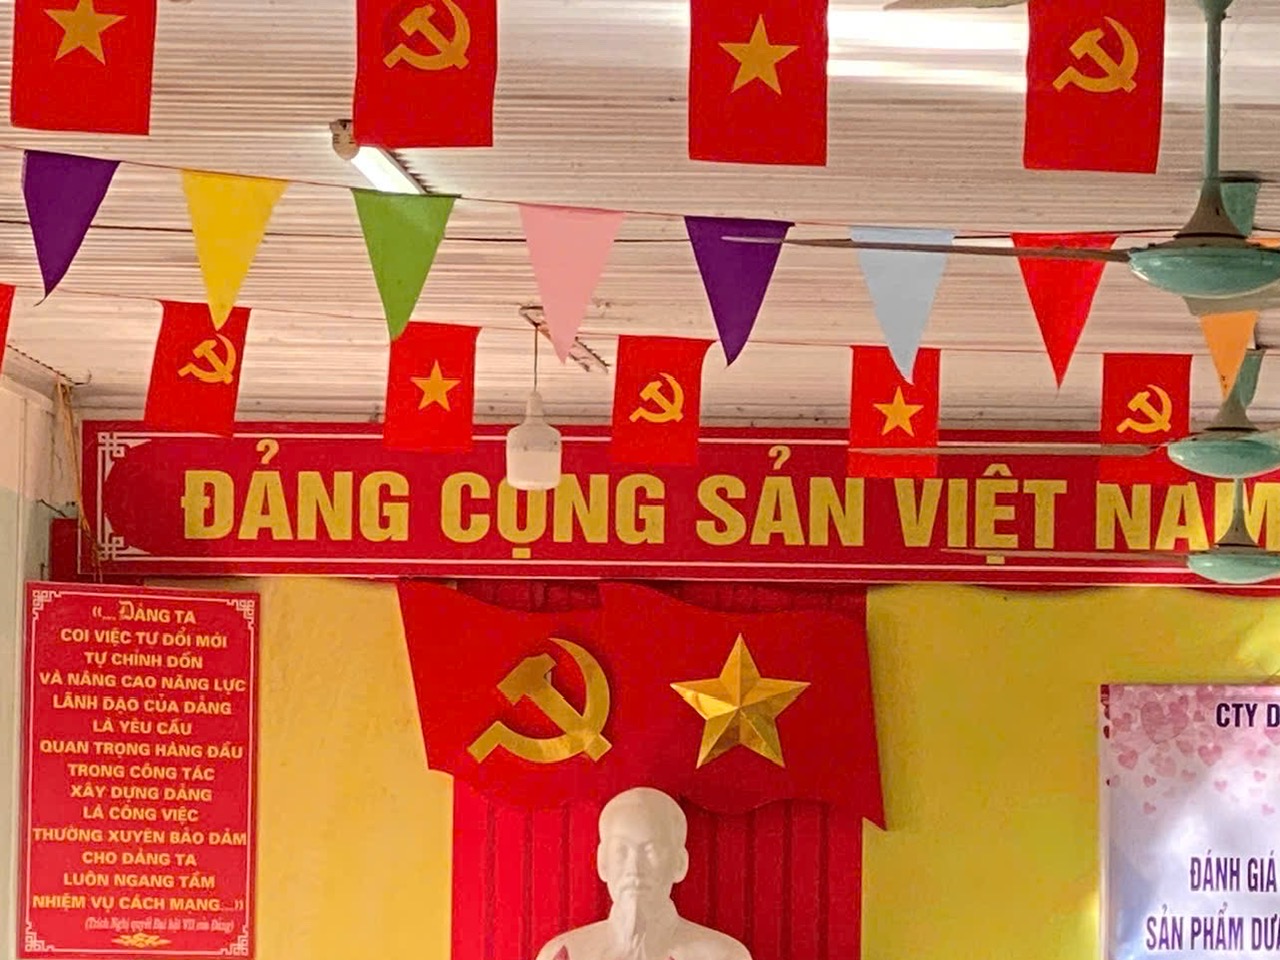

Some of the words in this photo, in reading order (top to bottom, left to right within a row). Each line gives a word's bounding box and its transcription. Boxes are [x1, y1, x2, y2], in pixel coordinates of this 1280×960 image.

[181, 438, 410, 543] ĐẢNG
[696, 445, 865, 547] SẢN
[893, 464, 1067, 565] VIỆT
[175, 610, 196, 624] TA
[61, 629, 89, 643] COI
[95, 628, 131, 645] VIỆC
[39, 669, 62, 685] VÀ
[121, 675, 156, 688] CAO
[214, 678, 246, 695] LỰC
[53, 692, 97, 709] LÃNH
[1215, 702, 1258, 729] CTY
[93, 717, 114, 733] LÀ
[120, 719, 151, 734] YÊU
[40, 740, 88, 754] QUAN
[93, 742, 150, 758] TRỌNG
[68, 764, 124, 778] TRONG
[182, 766, 215, 780] TÁC
[70, 783, 105, 798] XÂY
[161, 806, 198, 826] VIỆC
[82, 852, 117, 864] CHO
[175, 854, 197, 866] TA
[64, 871, 109, 886] LUÔN
[114, 874, 174, 887] NGANG
[1190, 849, 1240, 893] ĐÁNH
[1248, 850, 1277, 893] GIÁ
[91, 897, 114, 913] VỤ
[119, 894, 164, 910] CÁCH
[1146, 904, 1184, 951] SẢN
[1190, 902, 1244, 951] PHẨM
